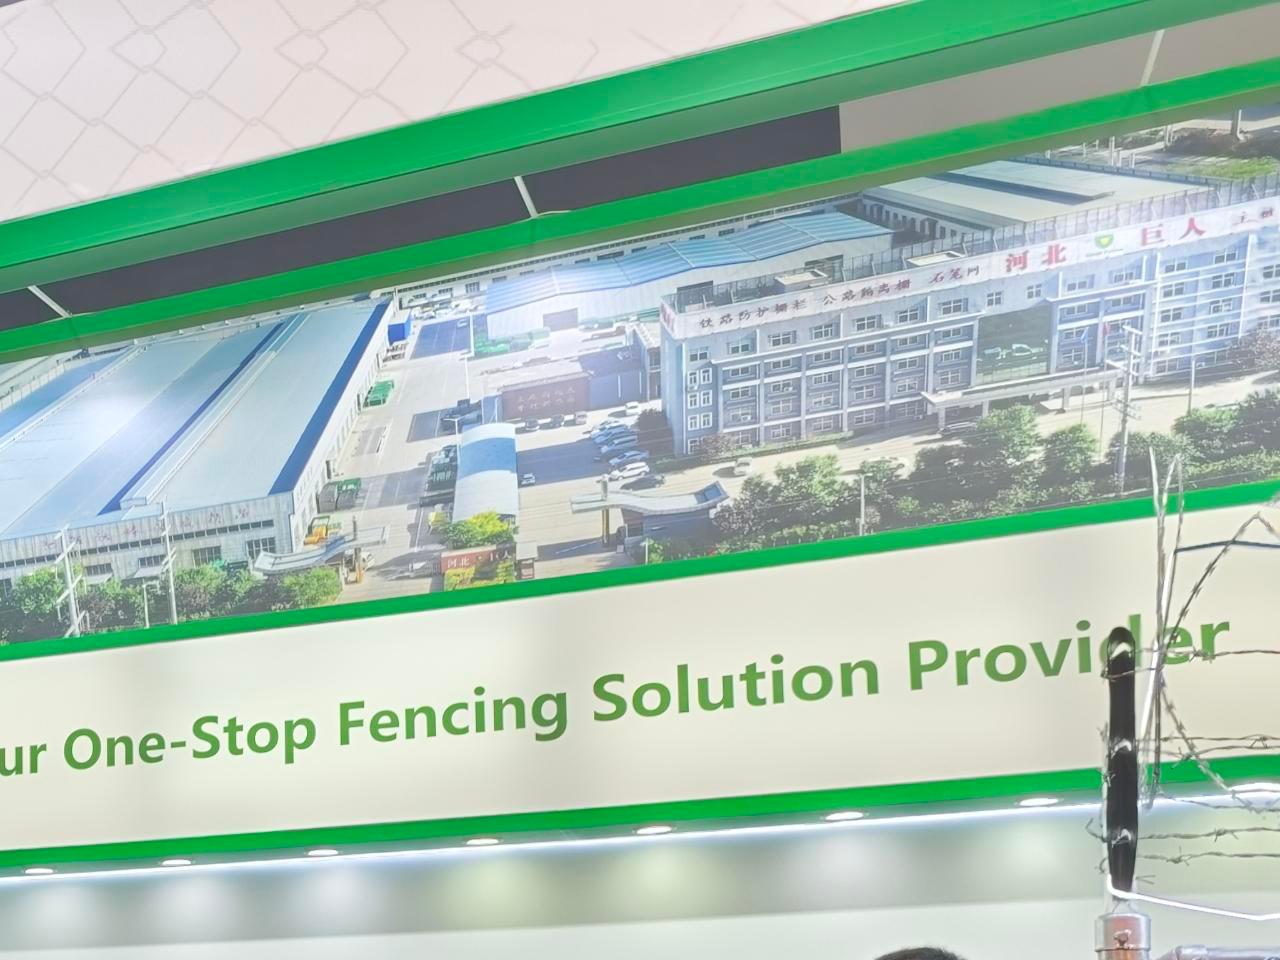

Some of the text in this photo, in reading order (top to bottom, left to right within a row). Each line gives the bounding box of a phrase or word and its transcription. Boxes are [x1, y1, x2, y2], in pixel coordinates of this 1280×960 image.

[1005, 243, 1067, 273] 河北
[1140, 217, 1206, 247] 巨人
[62, 713, 317, 770] One-Stop
[338, 686, 568, 742] Fencing
[592, 653, 880, 722] Solution
